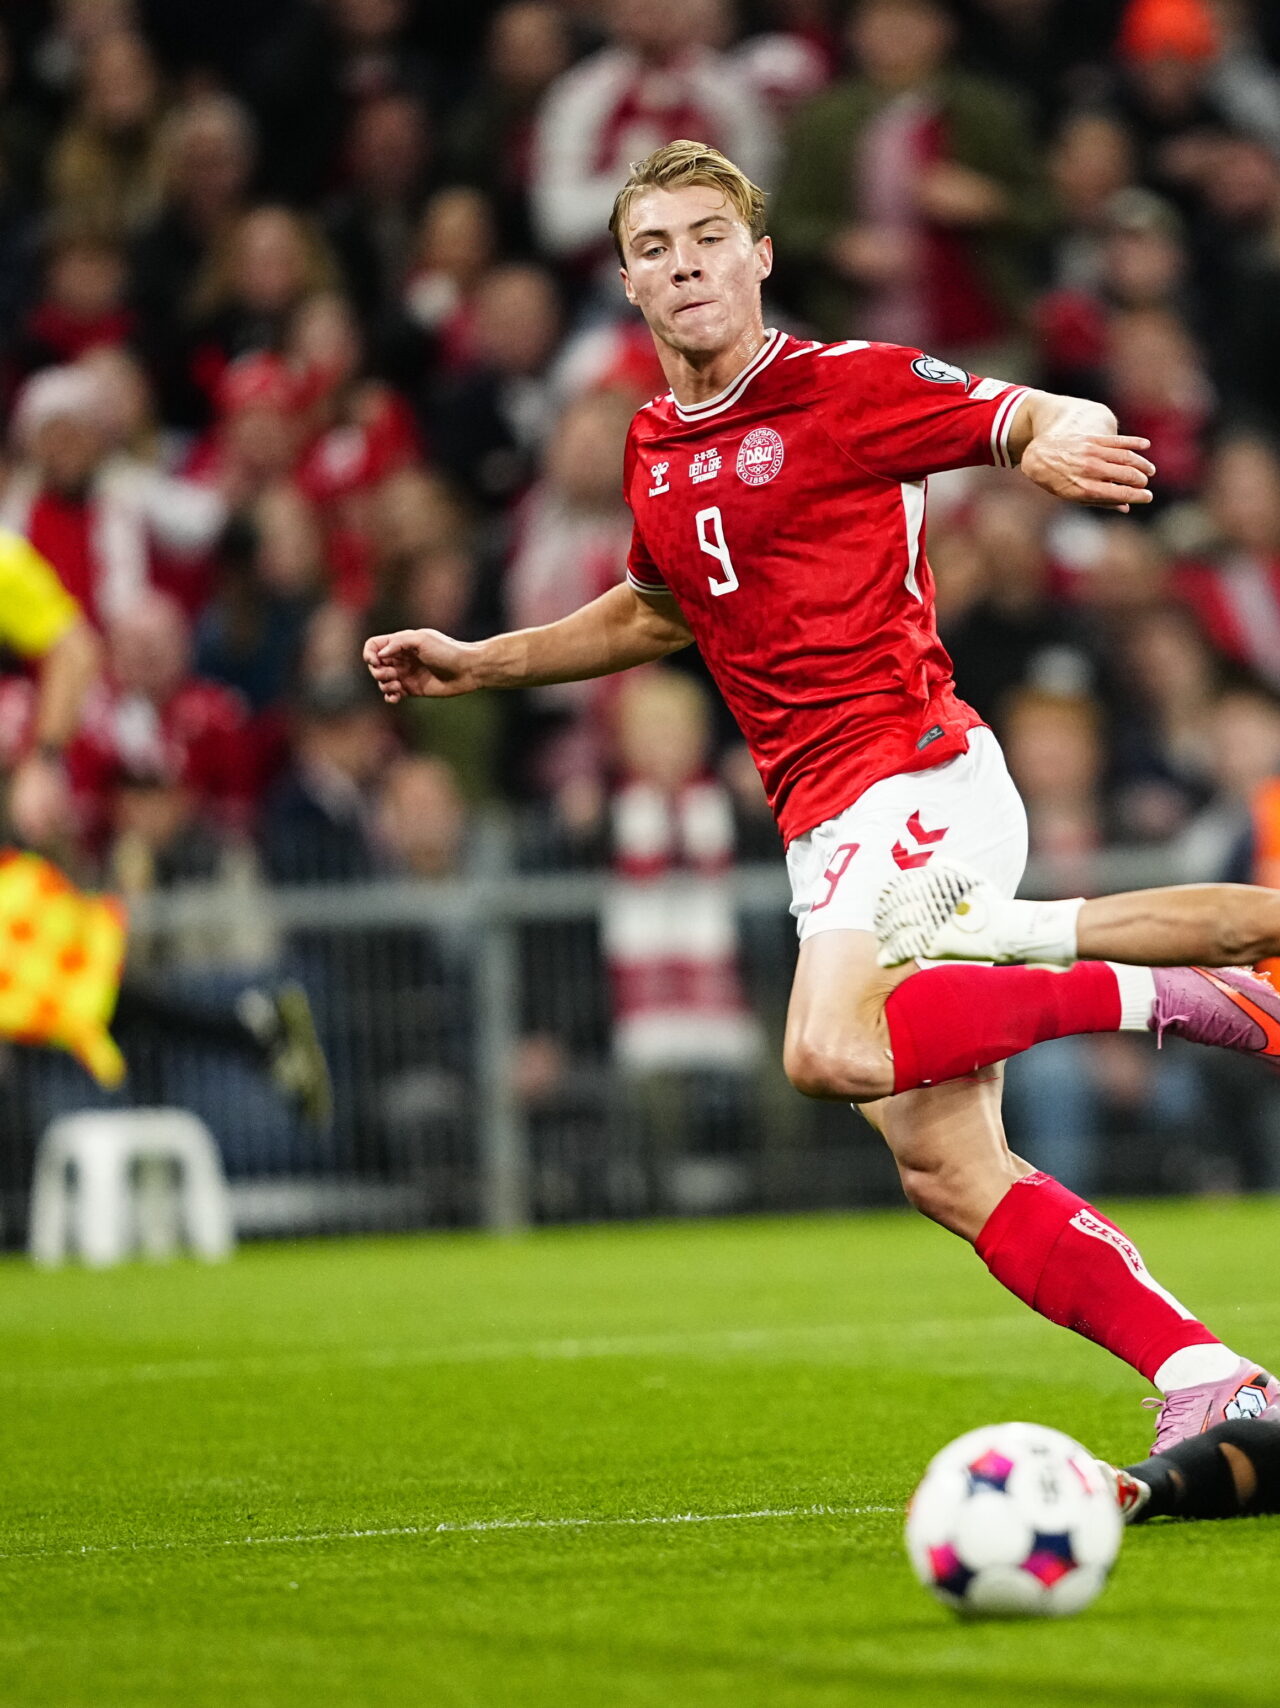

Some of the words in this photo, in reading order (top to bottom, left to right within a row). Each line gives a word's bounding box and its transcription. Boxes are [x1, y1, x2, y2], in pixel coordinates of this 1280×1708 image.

[745, 445, 774, 465] DBU
[749, 473, 770, 484] 1889
[695, 505, 740, 597] 9
[810, 842, 861, 913] 9
